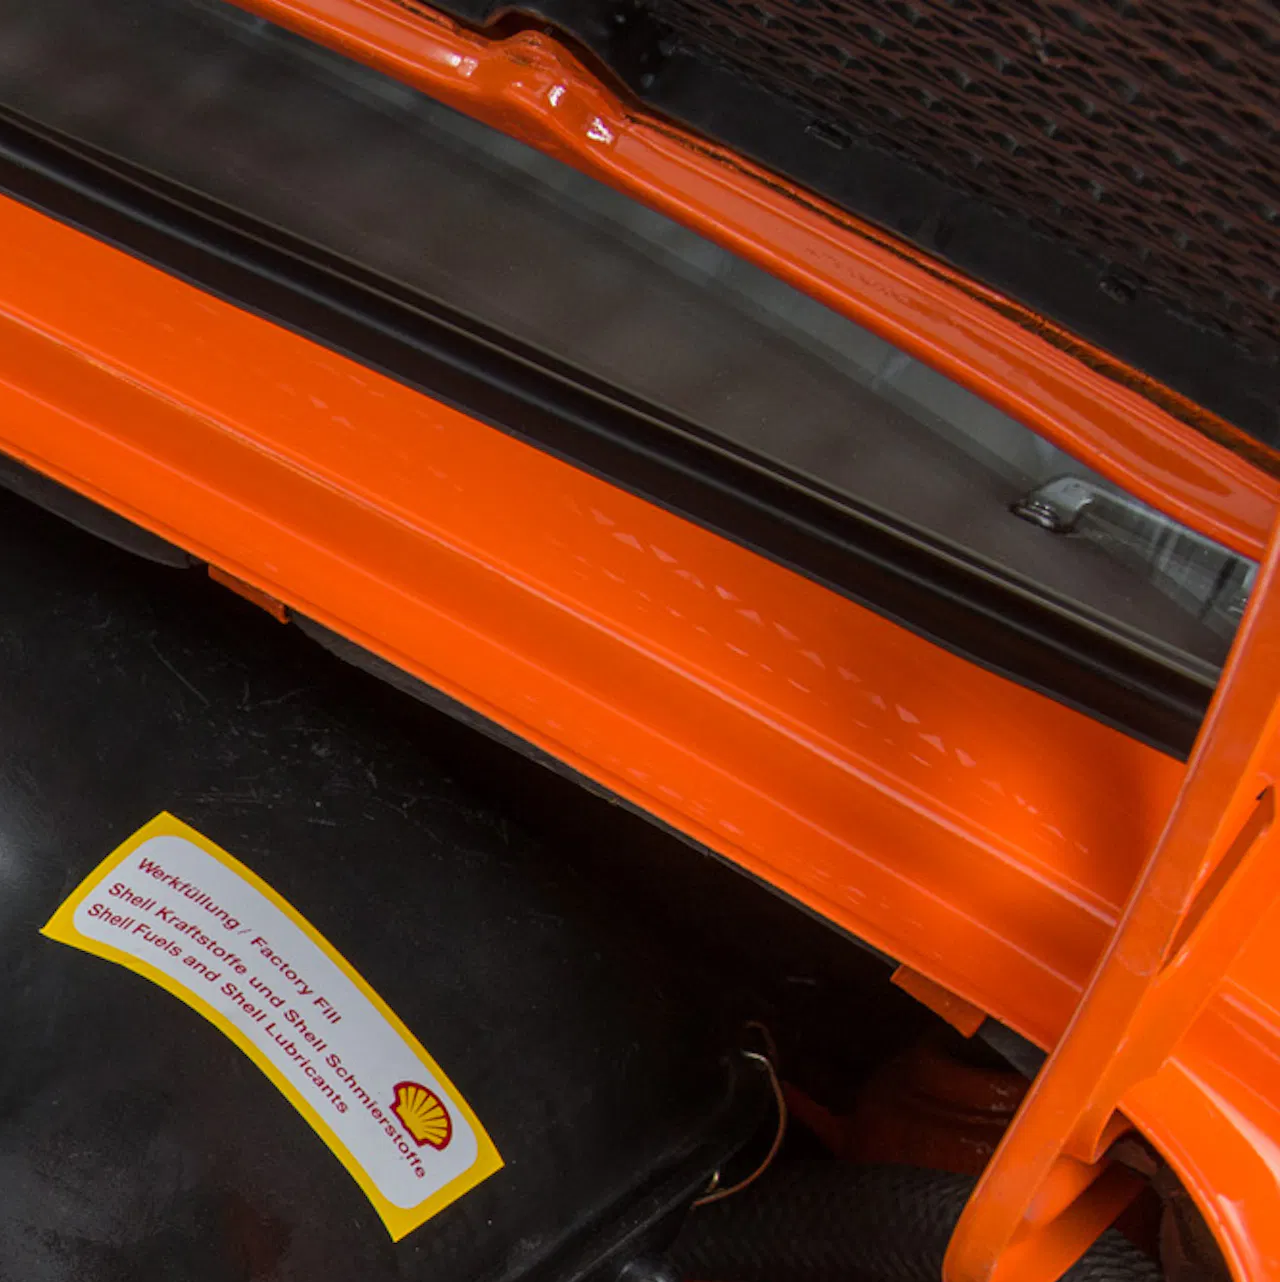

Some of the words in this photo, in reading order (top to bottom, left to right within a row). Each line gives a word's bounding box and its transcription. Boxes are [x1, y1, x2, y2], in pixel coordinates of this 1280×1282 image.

[86, 902, 134, 931] Shell
[132, 922, 183, 958] Fuels
[182, 954, 221, 983] and
[220, 981, 267, 1024] Shell
[264, 1021, 349, 1115] Lubricants
[107, 882, 157, 912] Shell
[155, 906, 248, 976] Kraftstoffe
[249, 976, 284, 1008] und
[283, 1008, 327, 1053] Shell
[324, 1052, 427, 1180] Schmierstoffe
[137, 857, 241, 933] Werkfüllung
[250, 935, 314, 998] Factory
[312, 996, 342, 1025] Fill
